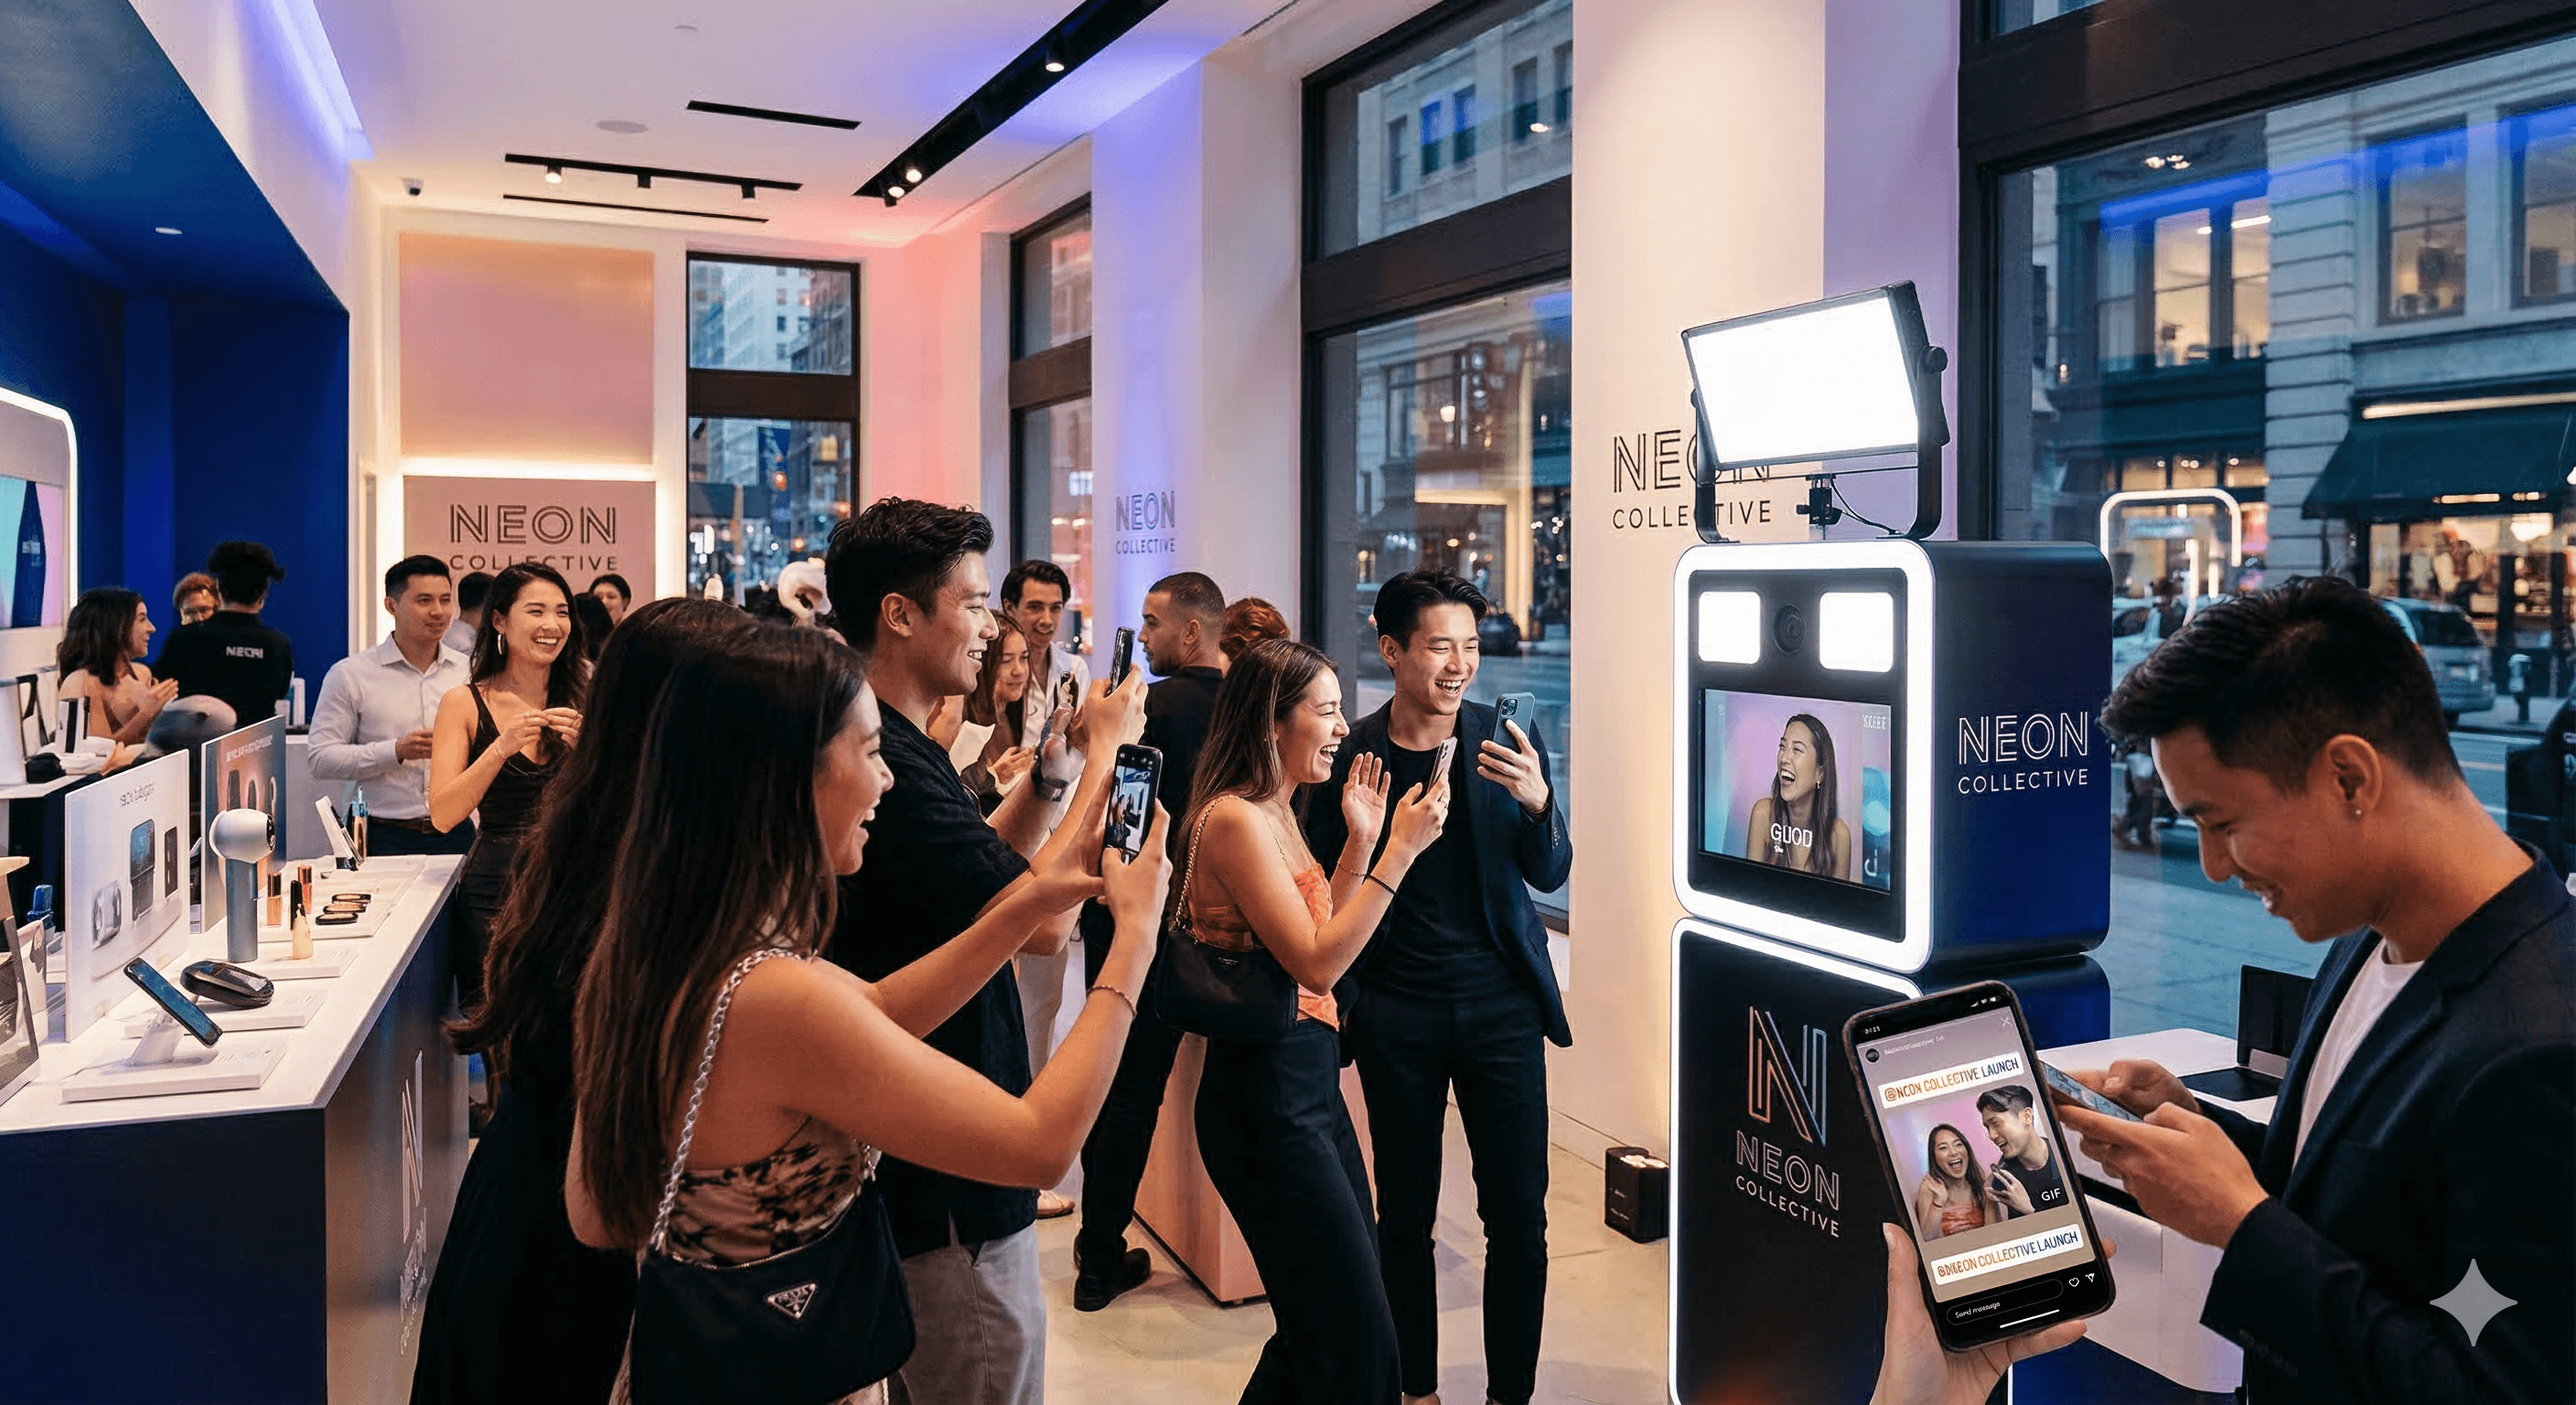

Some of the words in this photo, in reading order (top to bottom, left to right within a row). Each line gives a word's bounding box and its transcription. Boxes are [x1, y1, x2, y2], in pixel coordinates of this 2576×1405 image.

[450, 504, 617, 545] NEON
[1116, 490, 1175, 531] NEON
[1613, 500, 1771, 529] COLLETIVE
[1116, 538, 1175, 554] COLLECTIVE
[1959, 712, 2088, 765] NEON
[1958, 768, 2088, 794] COLLECTIVE
[1924, 1067, 1980, 1092] COLLECTIVE
[1980, 1057, 2020, 1078] LAUNCH
[1736, 1129, 1840, 1211] NEON
[1735, 1175, 1840, 1239] COLLECTIVE
[2041, 1187, 2061, 1202] GIF
[1978, 1242, 2037, 1268] COLLECTIVE
[2036, 1231, 2079, 1252] LAUNCH
